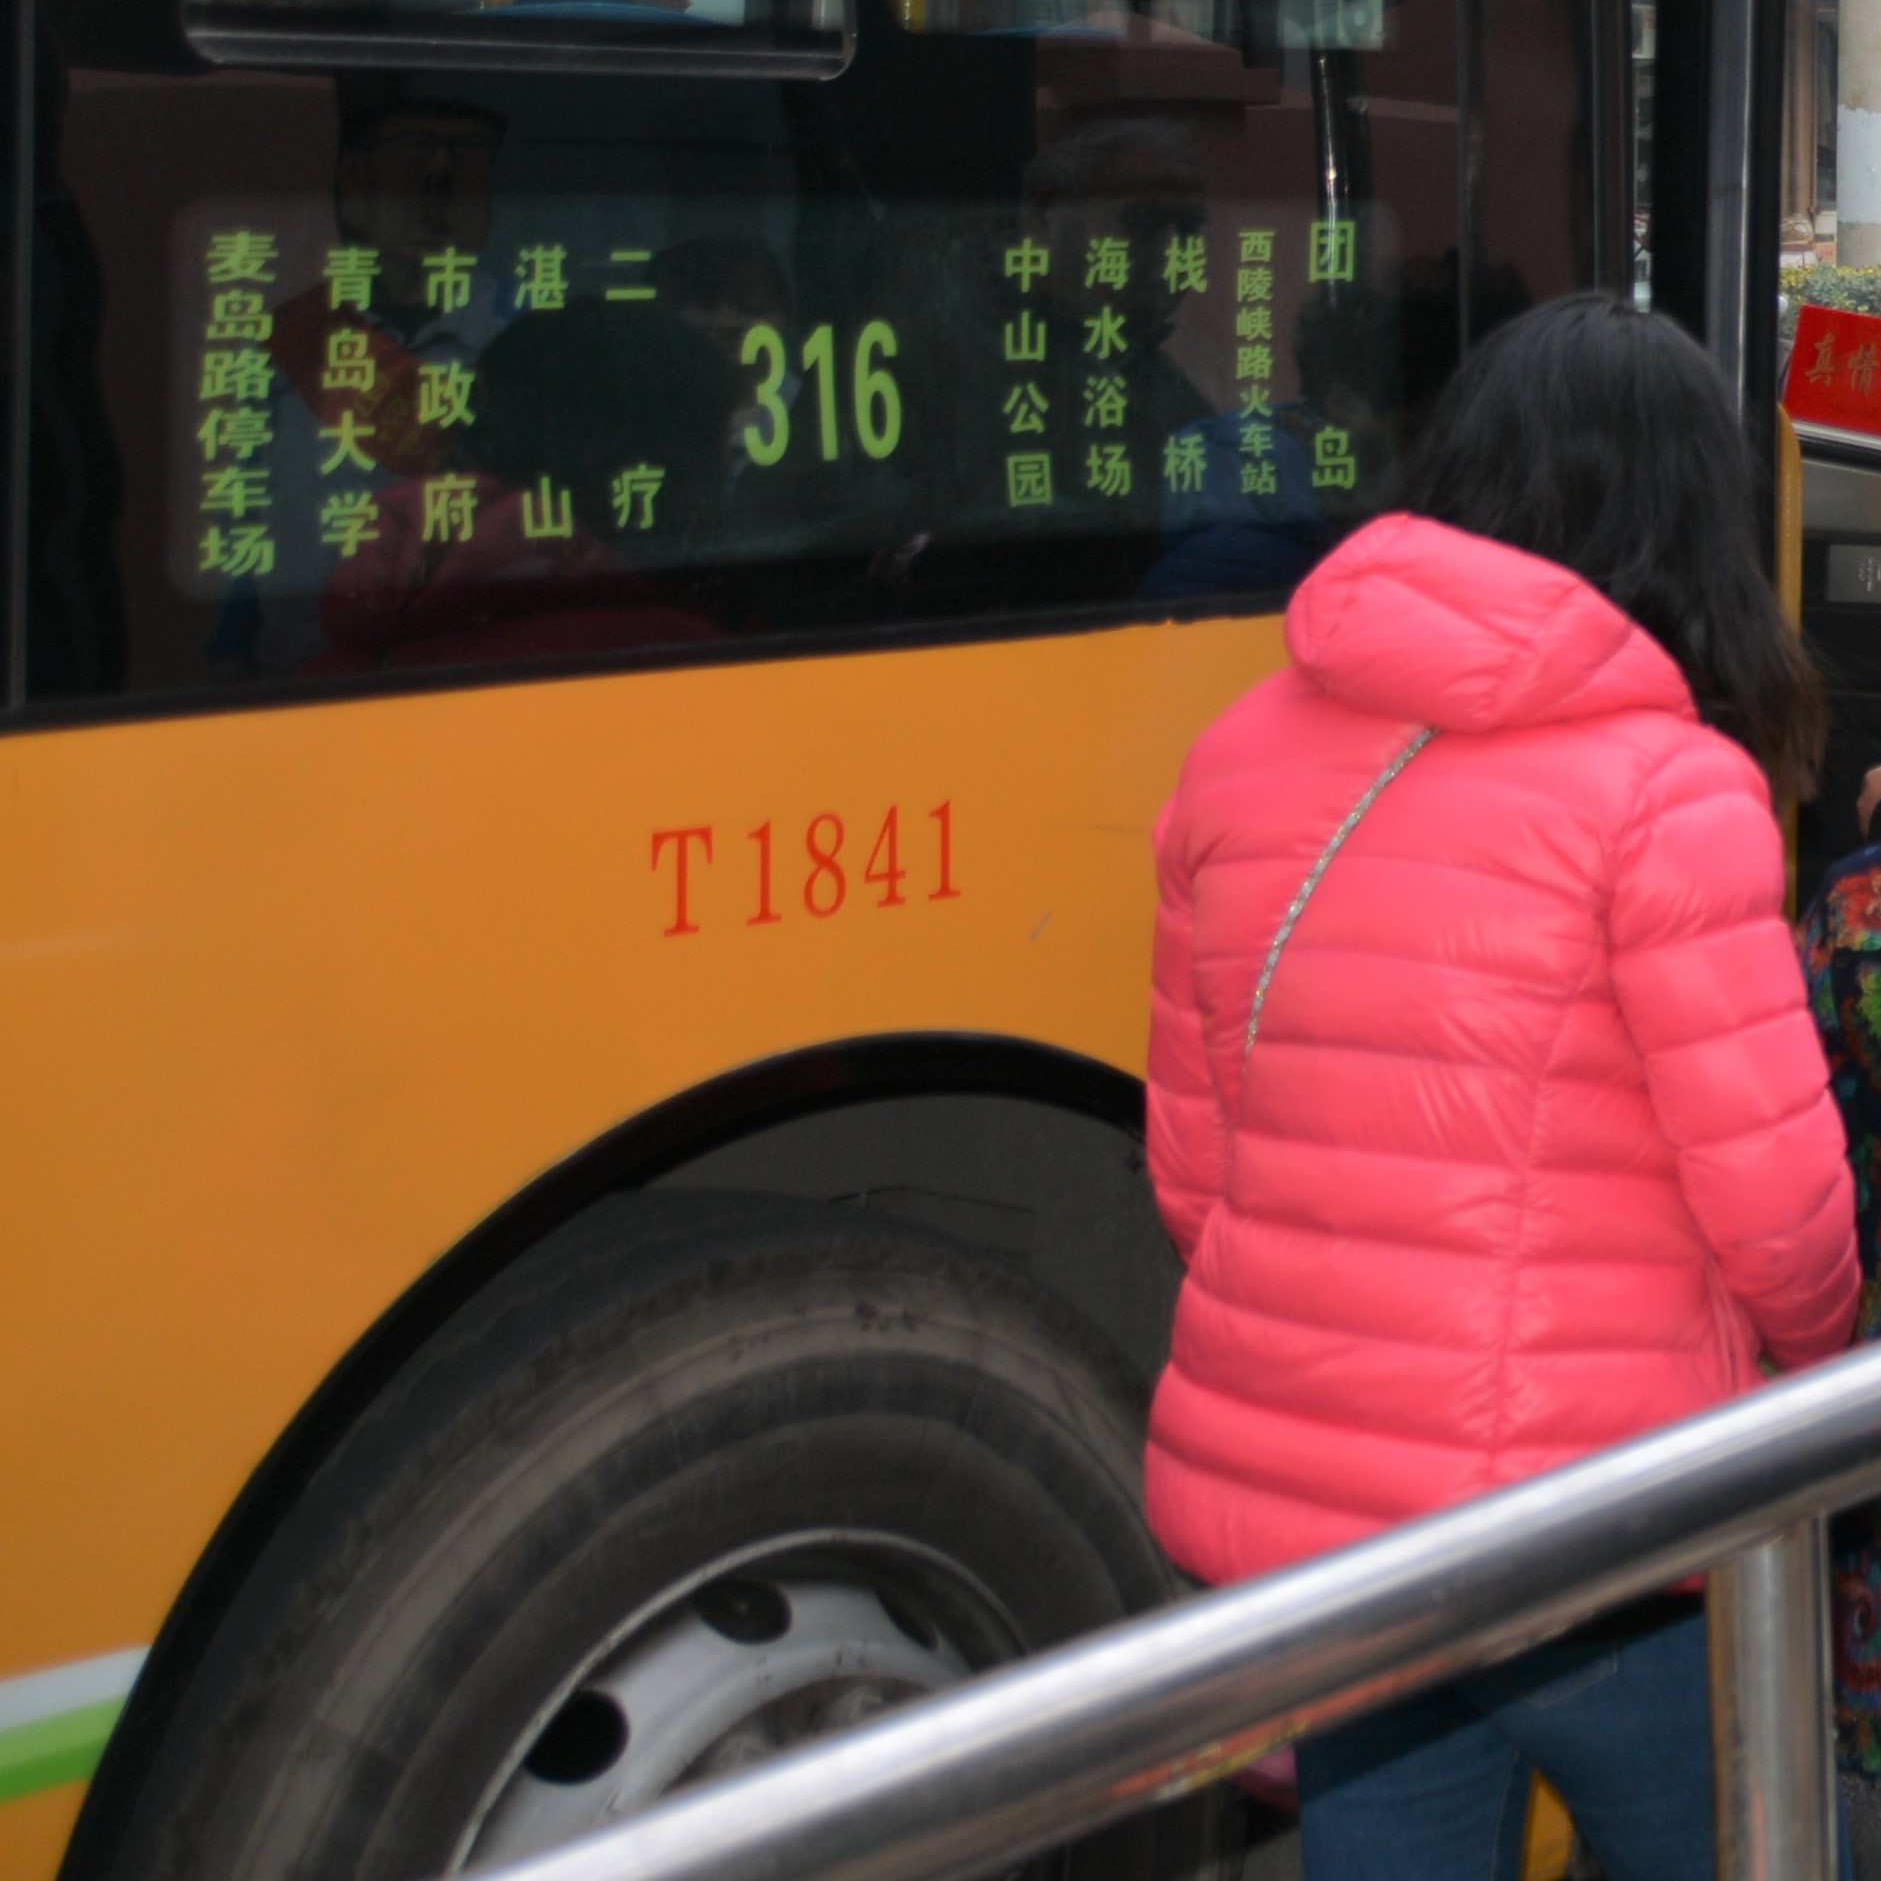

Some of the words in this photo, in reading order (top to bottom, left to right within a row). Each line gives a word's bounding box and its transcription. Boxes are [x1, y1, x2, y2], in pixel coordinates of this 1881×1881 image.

[199, 229, 277, 578] 麦岛路停车场
[320, 246, 381, 558] 青岛大学
[417, 248, 478, 544] 市政府
[516, 244, 572, 541] 湛山
[604, 251, 665, 533] 二疗
[741, 319, 903, 467] 316
[1003, 238, 1052, 508] 中山公园
[1084, 238, 1132, 500] 海水浴场
[1163, 238, 1208, 495] 栈桥
[1234, 229, 1278, 497] 西陵峡路火车站
[1308, 218, 1357, 493] 团岛
[651, 799, 963, 938] T1841
